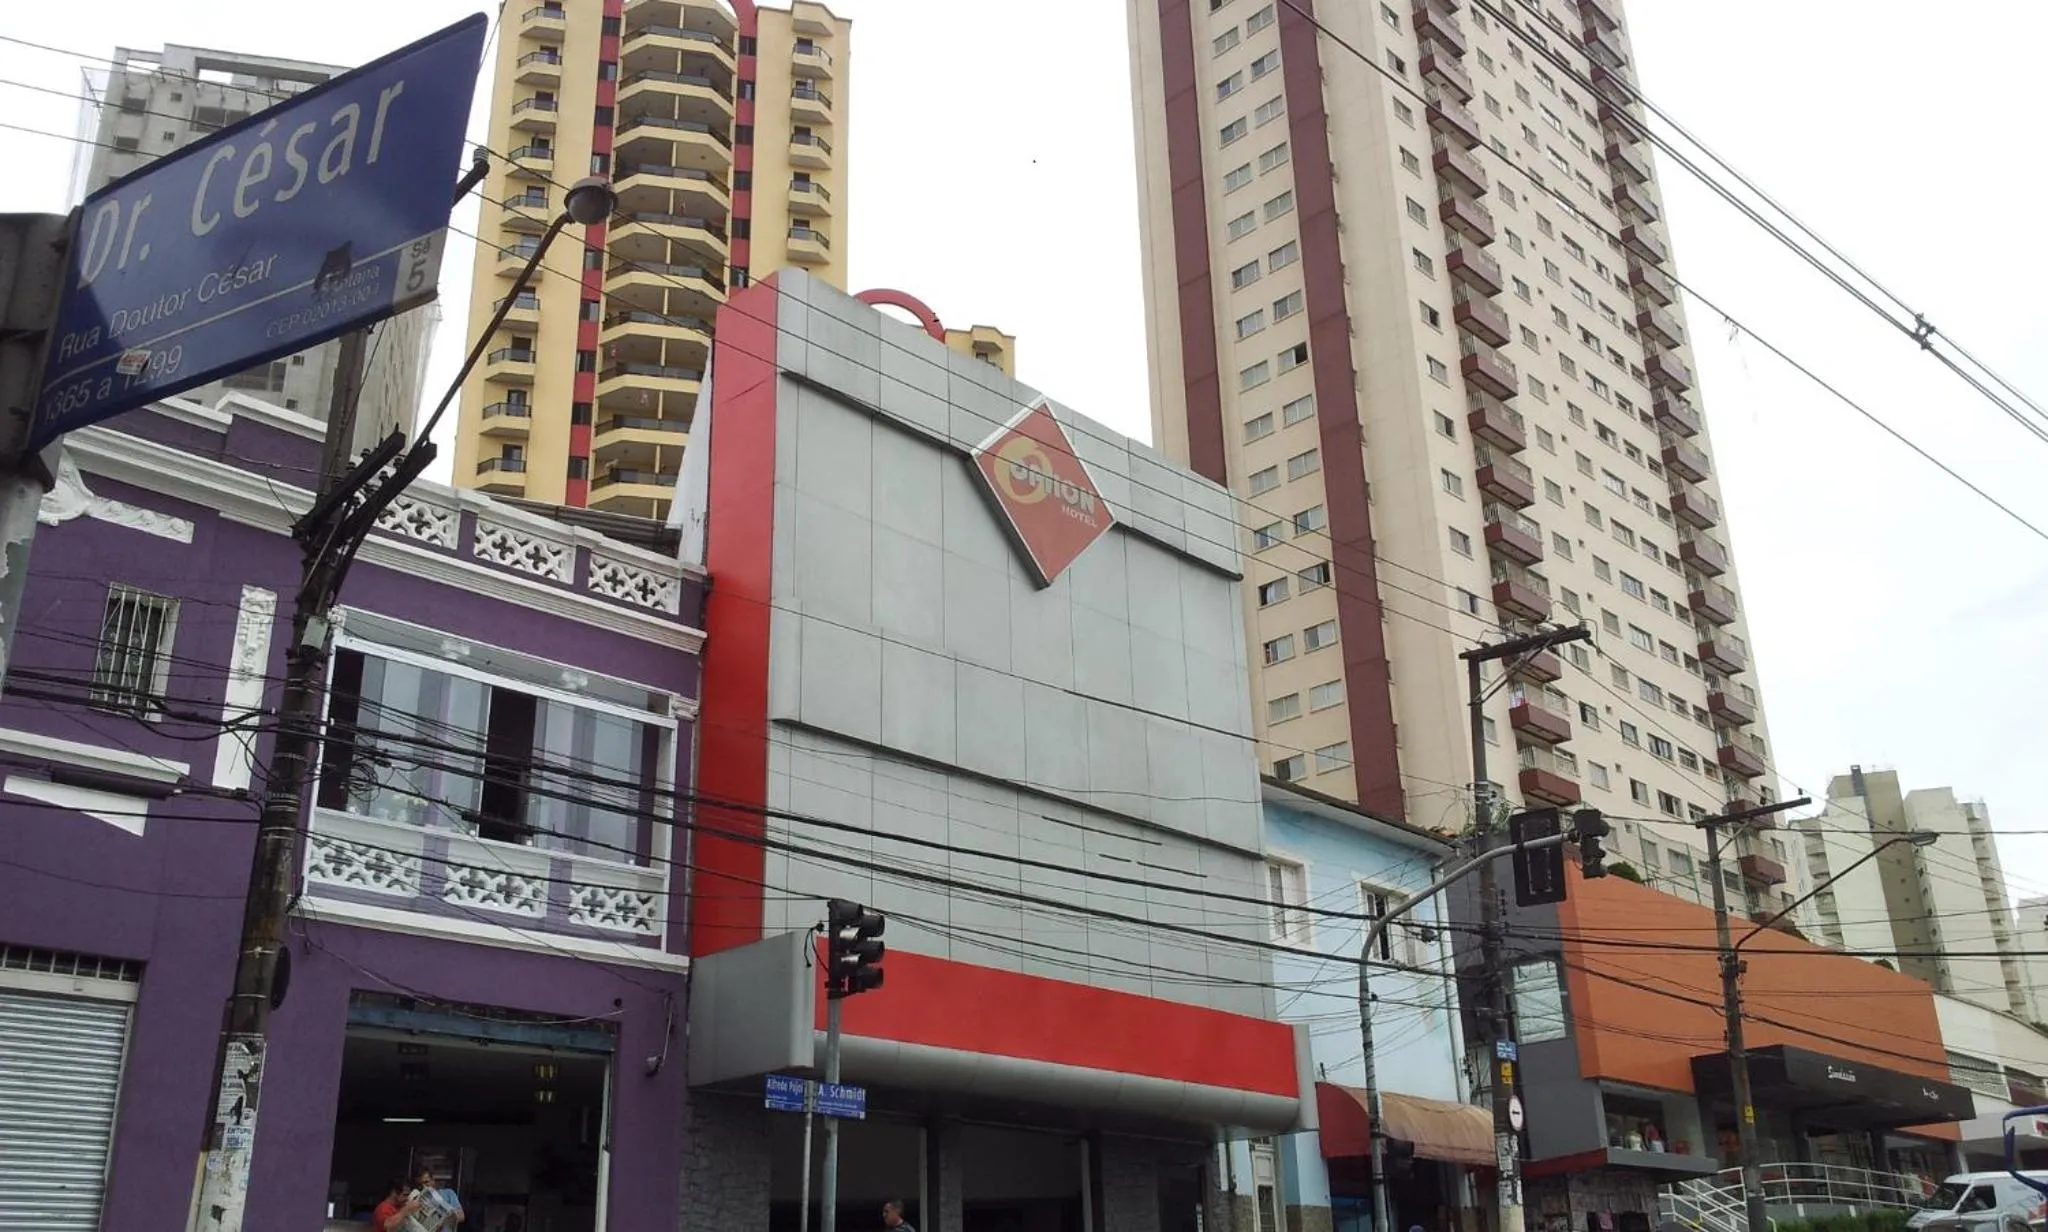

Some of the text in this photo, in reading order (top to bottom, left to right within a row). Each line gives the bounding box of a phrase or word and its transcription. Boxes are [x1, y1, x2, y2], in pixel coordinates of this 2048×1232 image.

[78, 80, 404, 289] Dr. César
[406, 259, 427, 292] 5
[58, 252, 280, 363] Rua Doutor César
[266, 313, 300, 338] CEP
[97, 376, 113, 401] a
[1061, 503, 1099, 528] HOTEL
